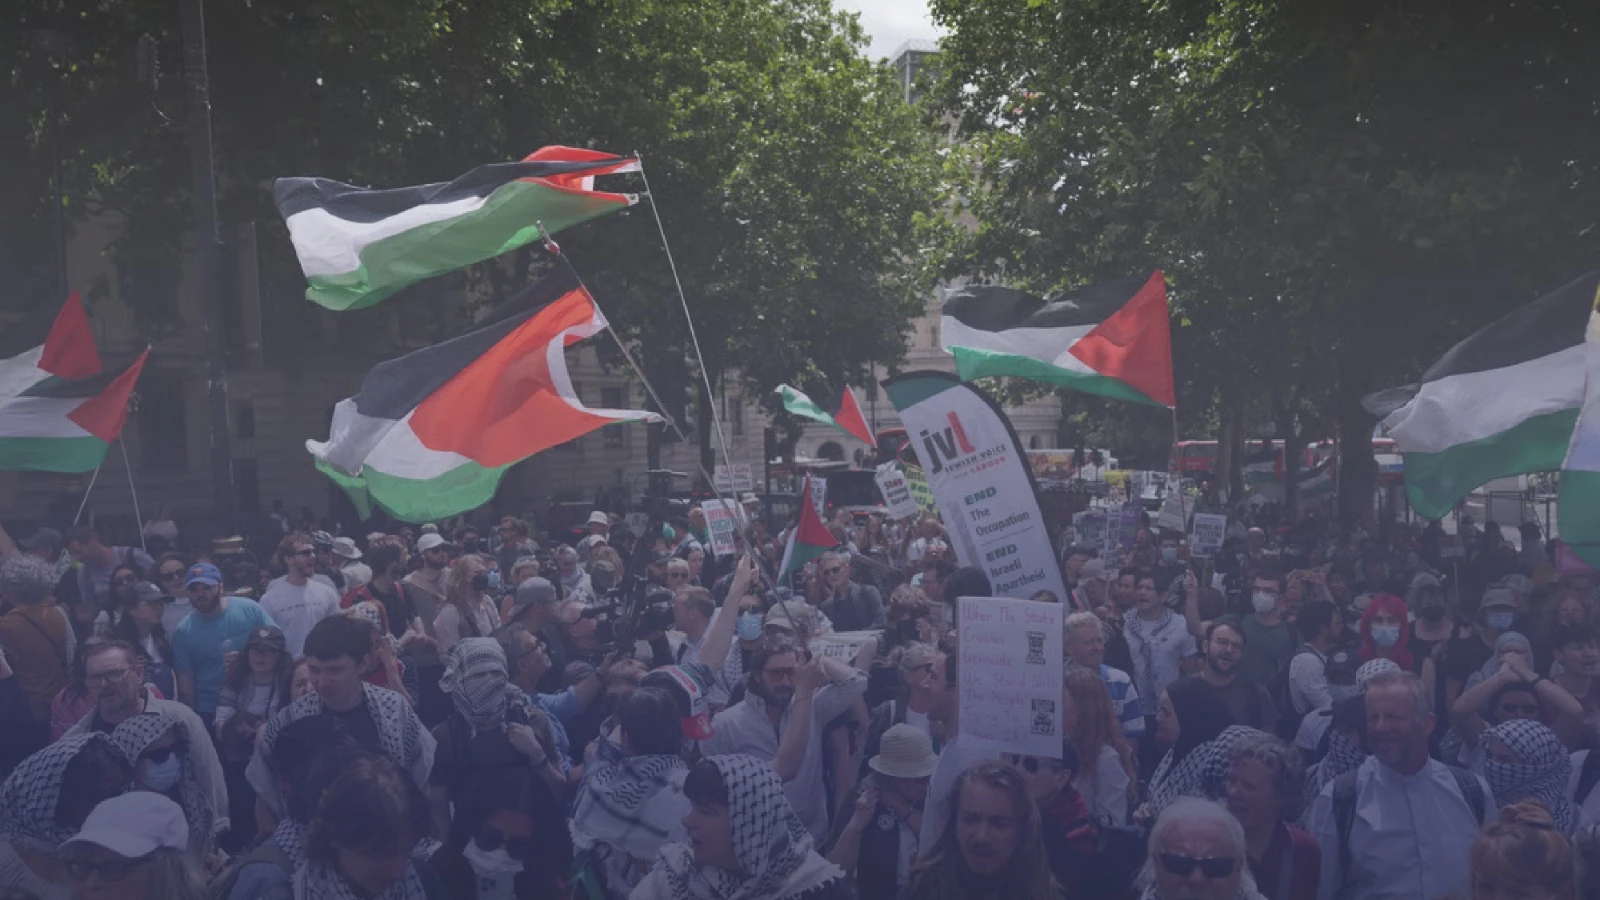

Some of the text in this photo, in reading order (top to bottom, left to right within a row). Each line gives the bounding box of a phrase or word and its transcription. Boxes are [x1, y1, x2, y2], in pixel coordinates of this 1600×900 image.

[945, 444, 1006, 473] JEWISH VOICE
[884, 478, 903, 490] Stop
[964, 486, 997, 506] END
[969, 508, 991, 521] The
[975, 511, 1030, 537] Occupation
[985, 543, 1018, 562] END
[990, 557, 1022, 578] Israeli
[995, 568, 1046, 594] Apartheid
[963, 602, 1055, 624] When The State
[963, 626, 1005, 645] Enables
[963, 646, 1013, 667] Genocide
[964, 670, 982, 686] We
[993, 672, 1025, 687] Stand
[965, 689, 1025, 709] The People
[963, 705, 999, 727] Trying
[1004, 710, 1019, 722] To
